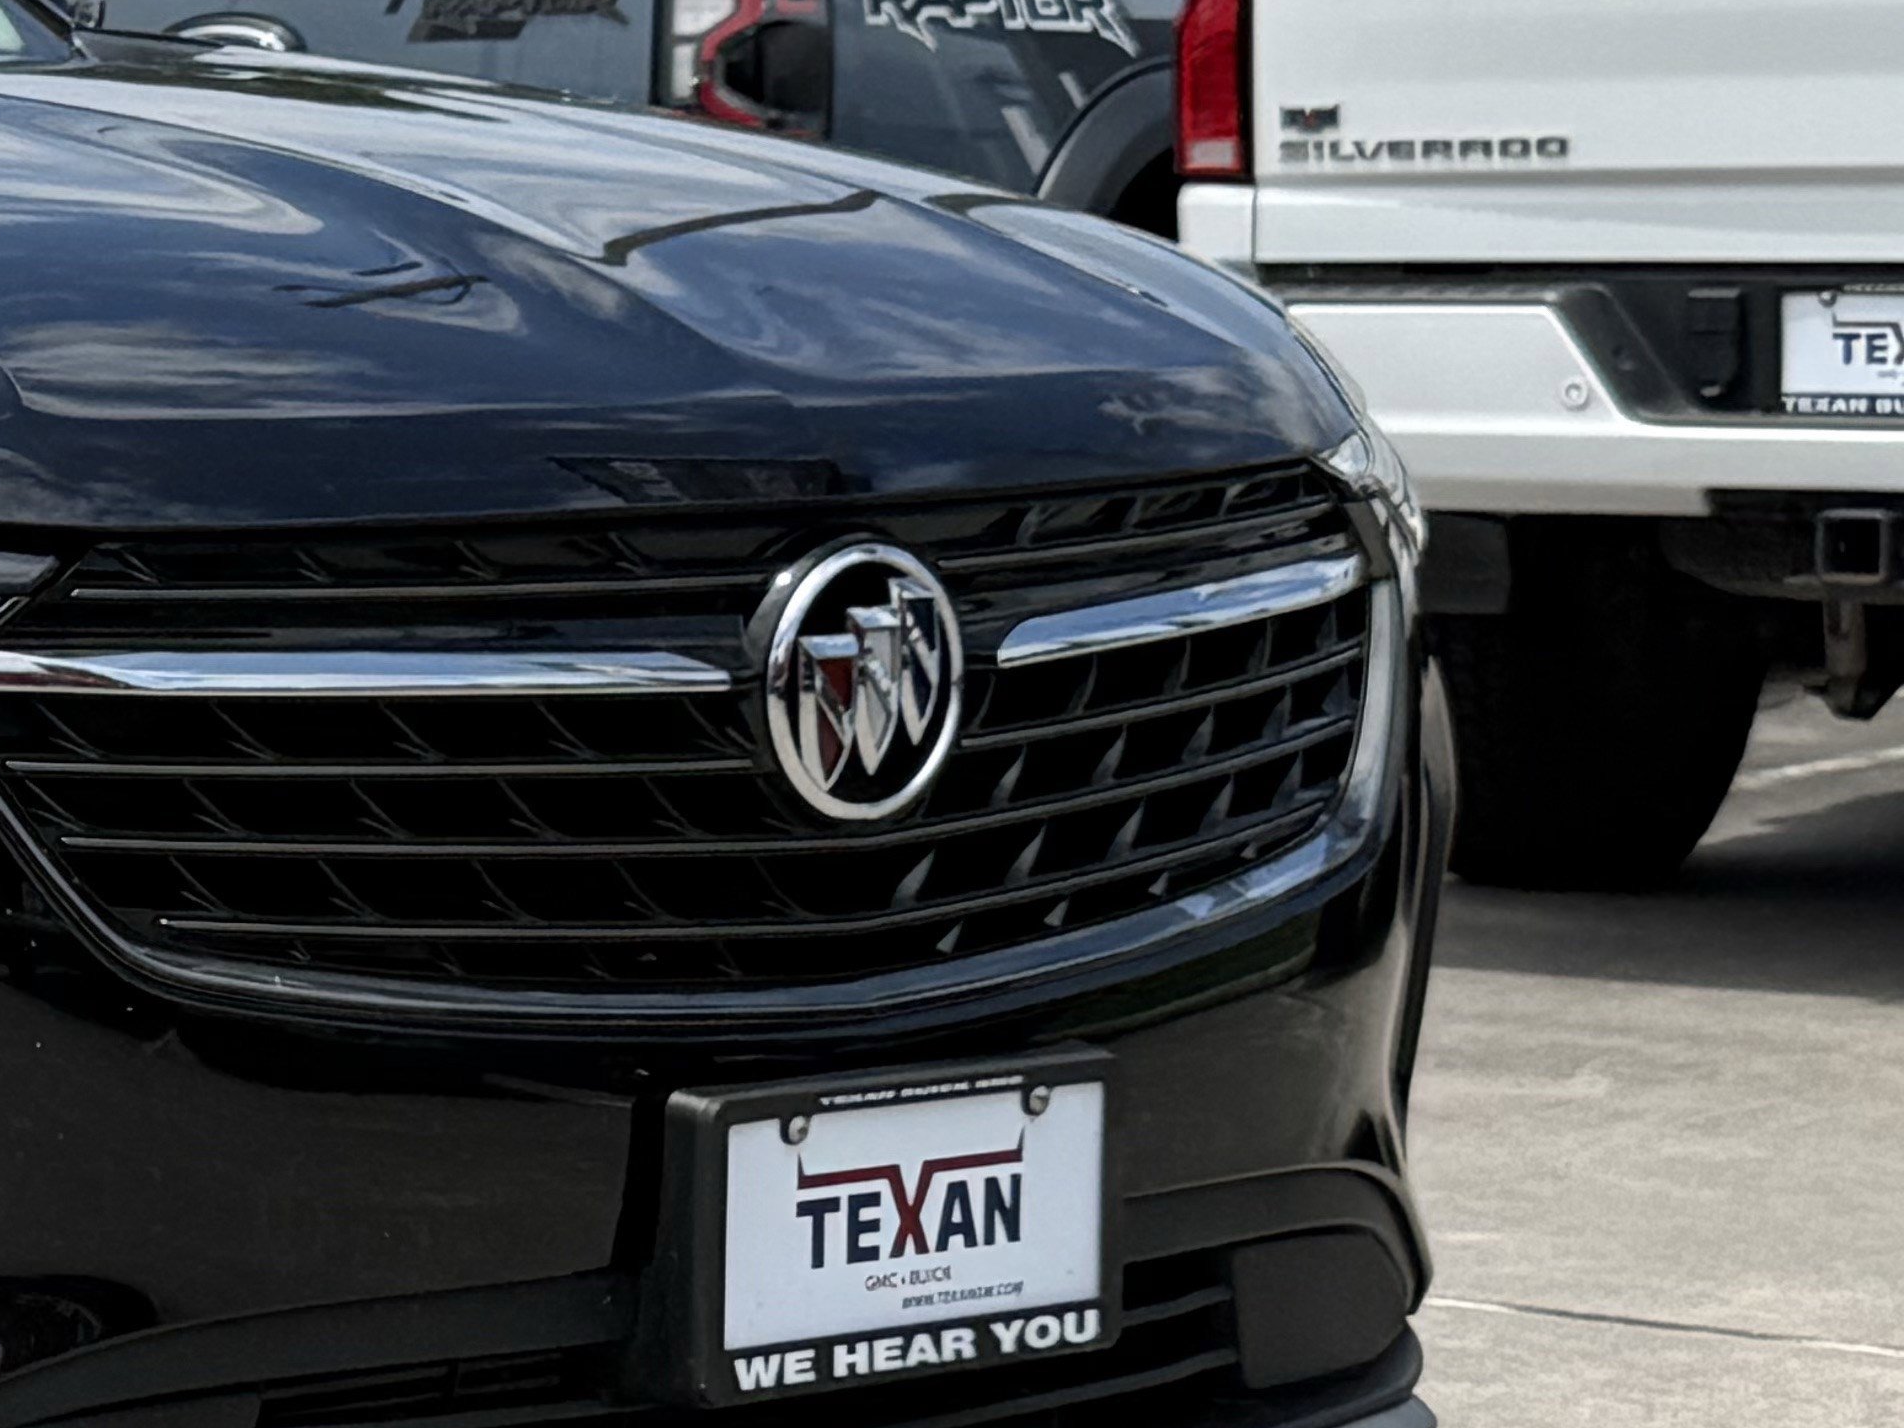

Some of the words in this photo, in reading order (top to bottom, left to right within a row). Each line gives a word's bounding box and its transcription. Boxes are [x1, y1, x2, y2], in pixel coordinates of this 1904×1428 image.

[1280, 137, 1569, 163] SILVERADO
[796, 1150, 1023, 1269] TEXAN
[734, 1349, 816, 1392] WE
[832, 1327, 977, 1378] HEAR
[989, 1308, 1101, 1354] YOU
